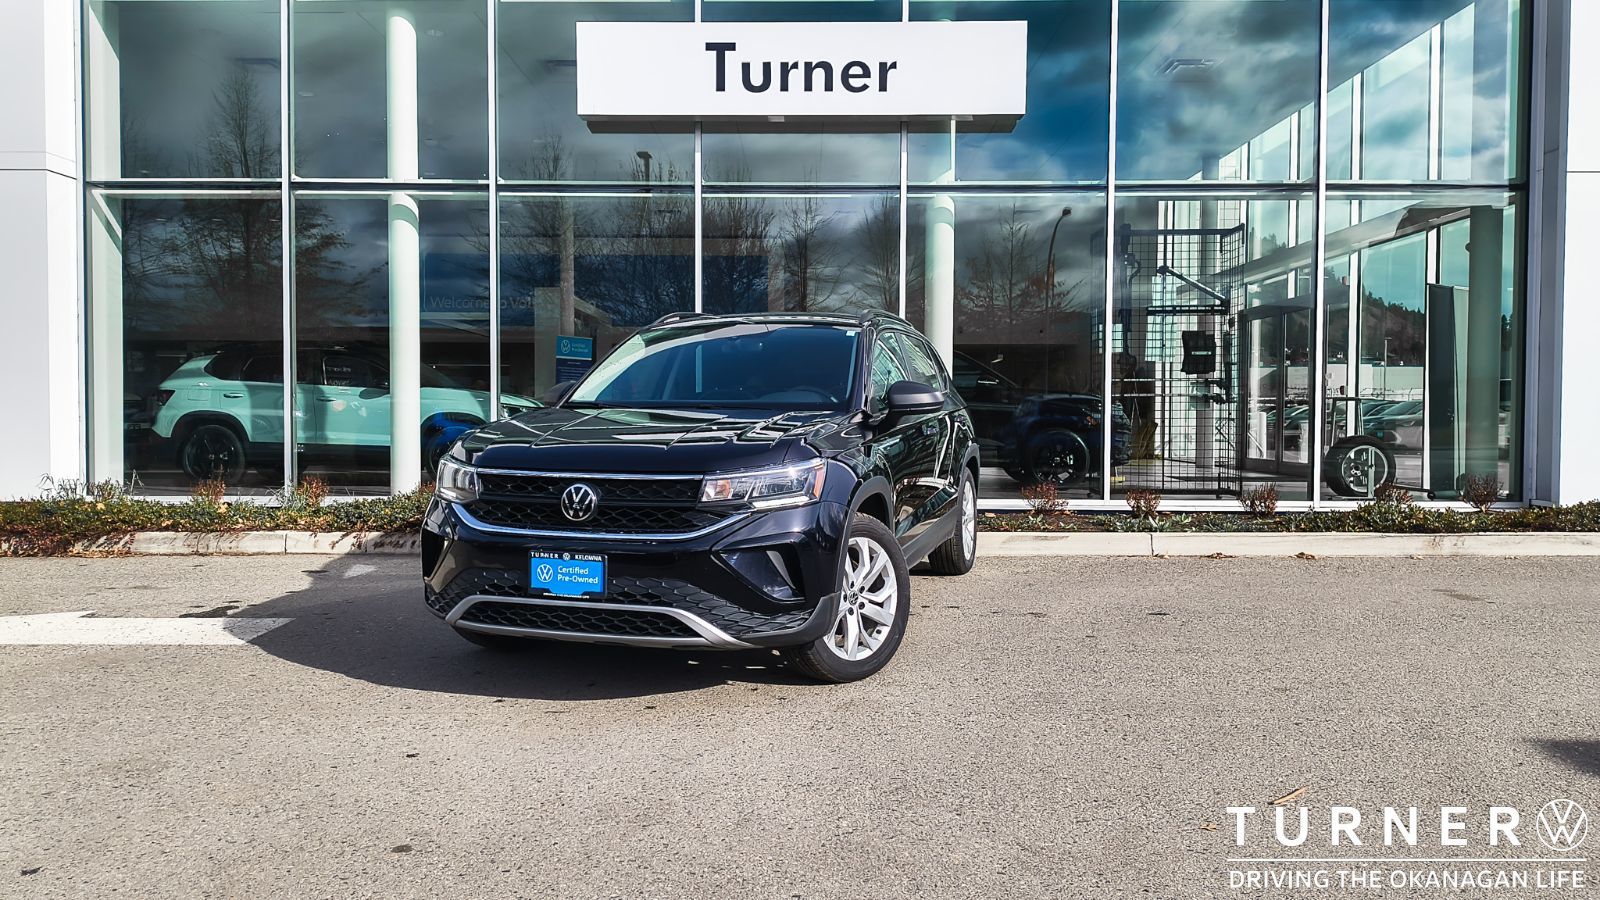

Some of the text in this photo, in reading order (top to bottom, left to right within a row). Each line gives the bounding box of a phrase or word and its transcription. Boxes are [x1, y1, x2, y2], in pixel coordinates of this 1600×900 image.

[705, 42, 897, 93] Turner
[557, 565, 589, 574] Certified
[557, 574, 599, 584] Pre-Owned
